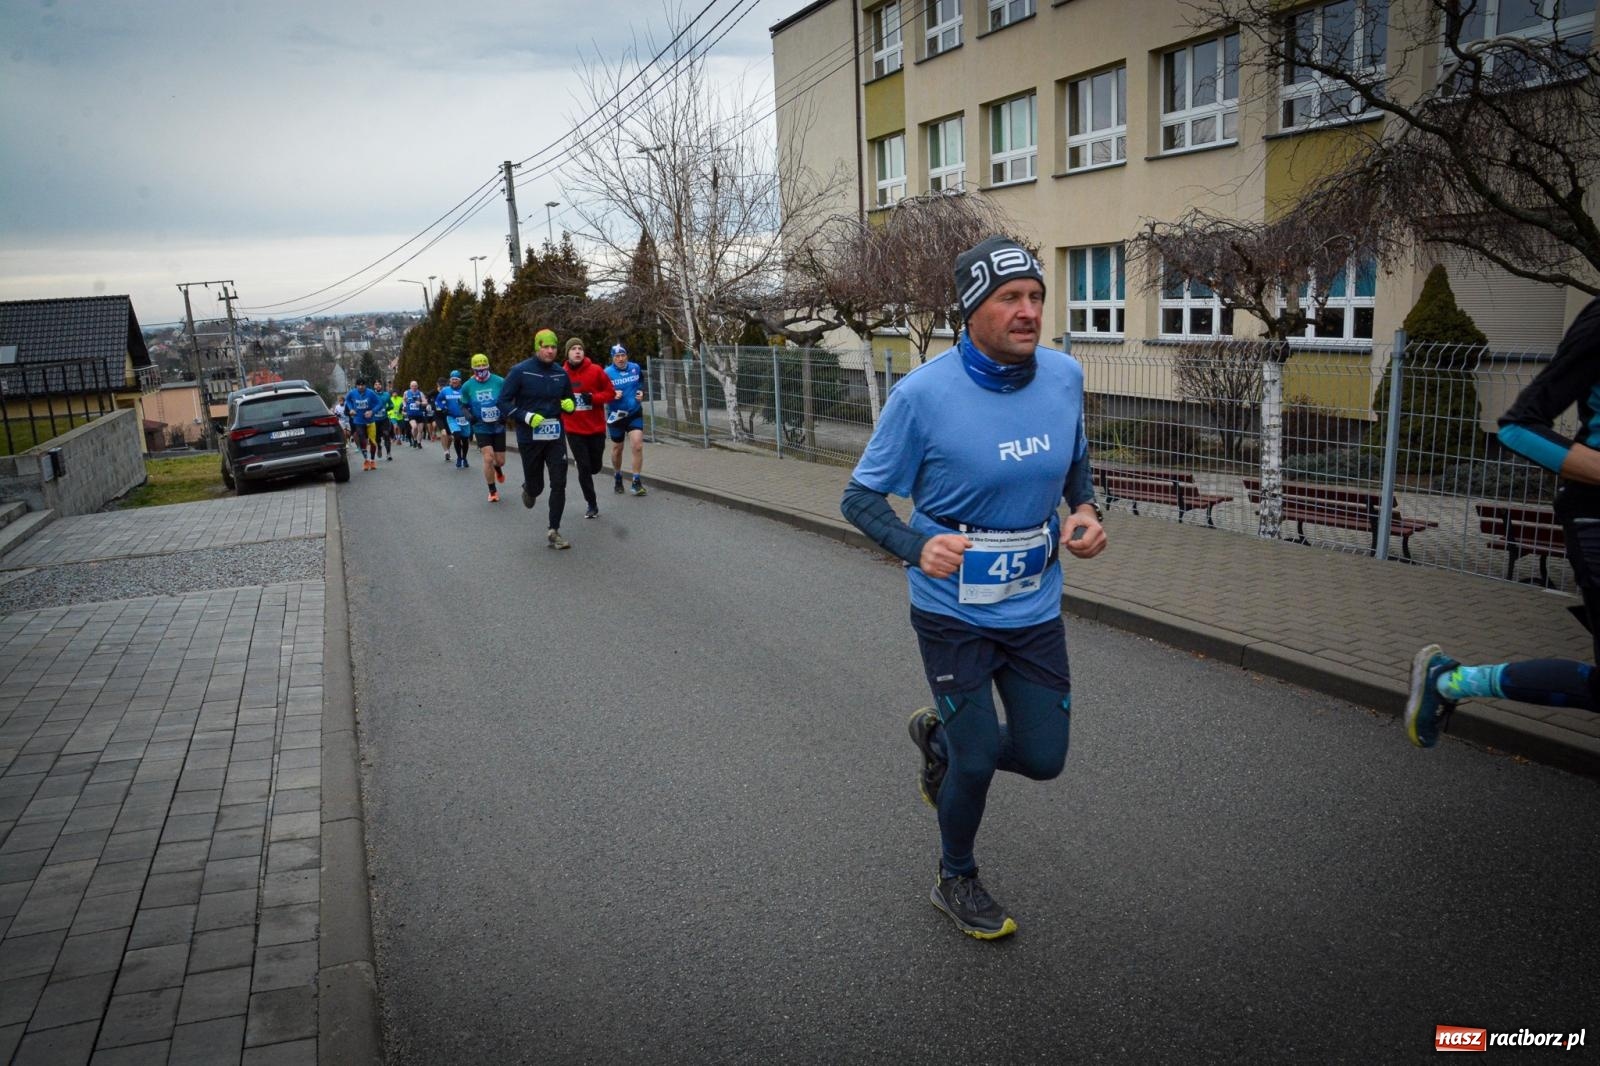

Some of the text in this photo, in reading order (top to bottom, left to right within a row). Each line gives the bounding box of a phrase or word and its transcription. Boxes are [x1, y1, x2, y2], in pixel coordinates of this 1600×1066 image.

[538, 424, 557, 434] 204
[998, 434, 1050, 461] RUN
[987, 551, 1028, 581] 45
